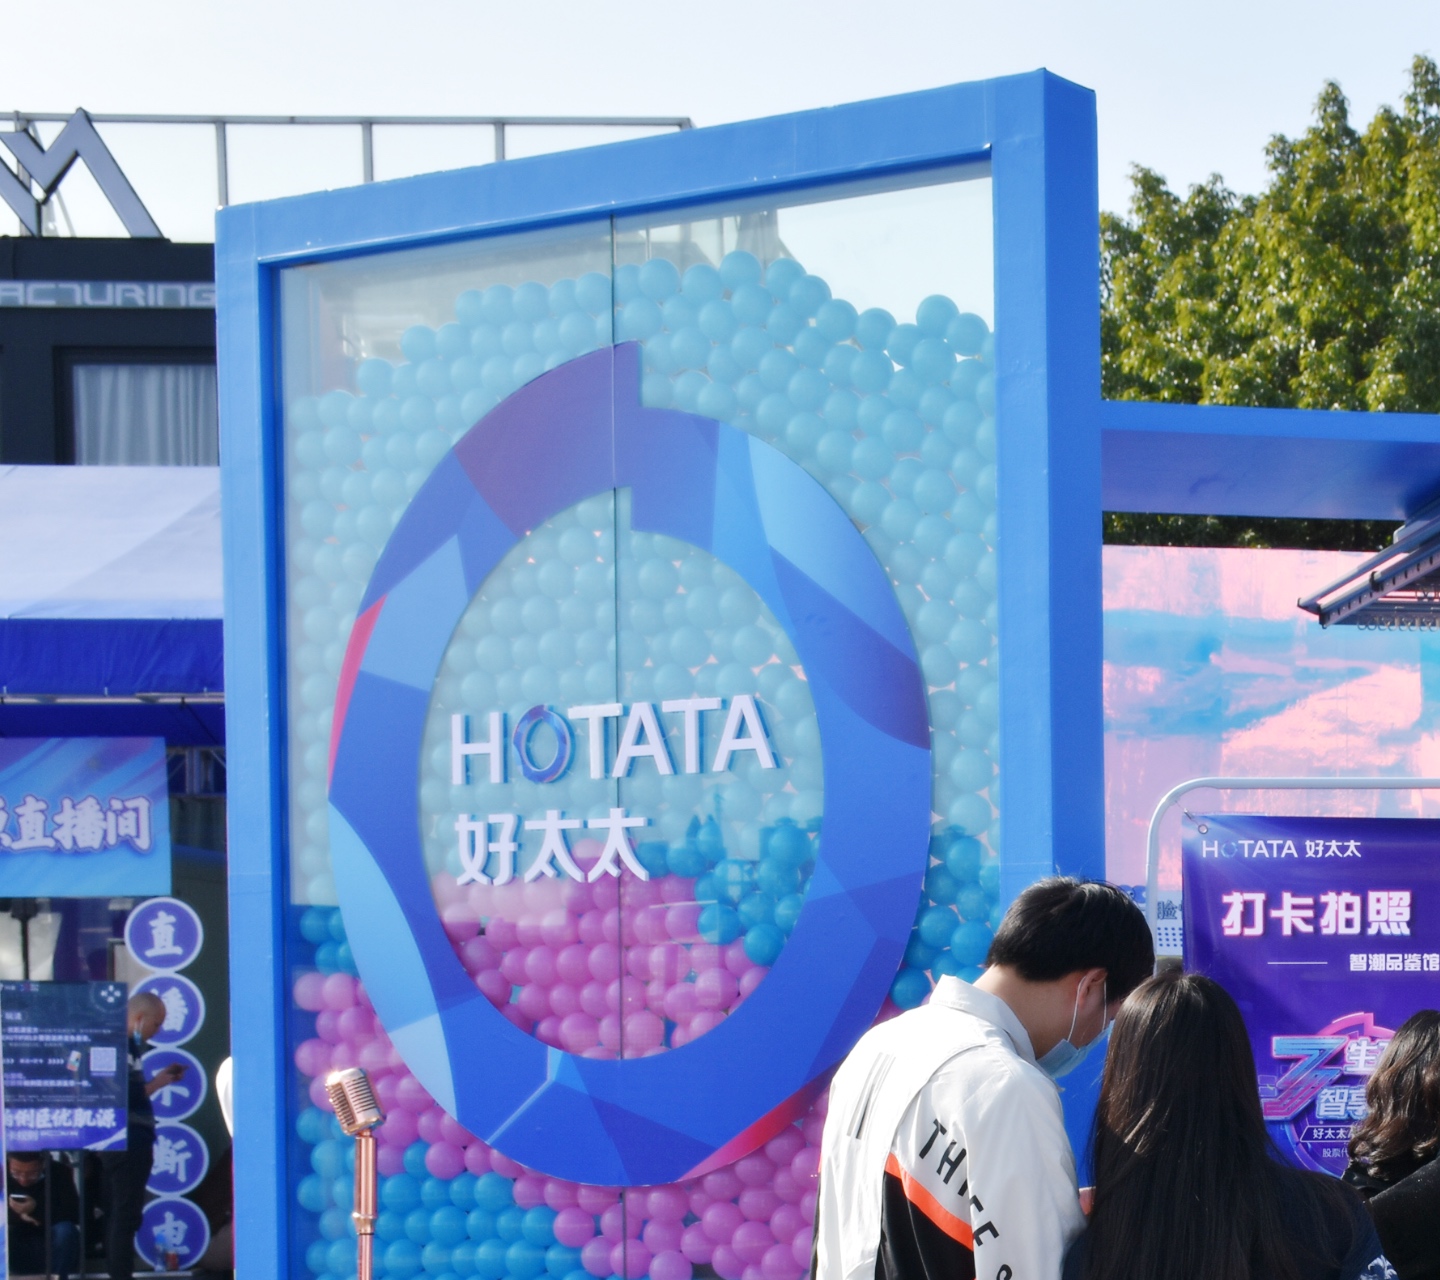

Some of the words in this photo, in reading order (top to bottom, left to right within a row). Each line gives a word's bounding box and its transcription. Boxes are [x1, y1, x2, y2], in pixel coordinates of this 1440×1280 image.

[451, 695, 777, 784] HOTATA
[455, 808, 650, 886] 好太太
[1202, 840, 1298, 858] HOTATA
[1305, 840, 1362, 858] 好太太
[1222, 890, 1412, 937] 打卡拍照
